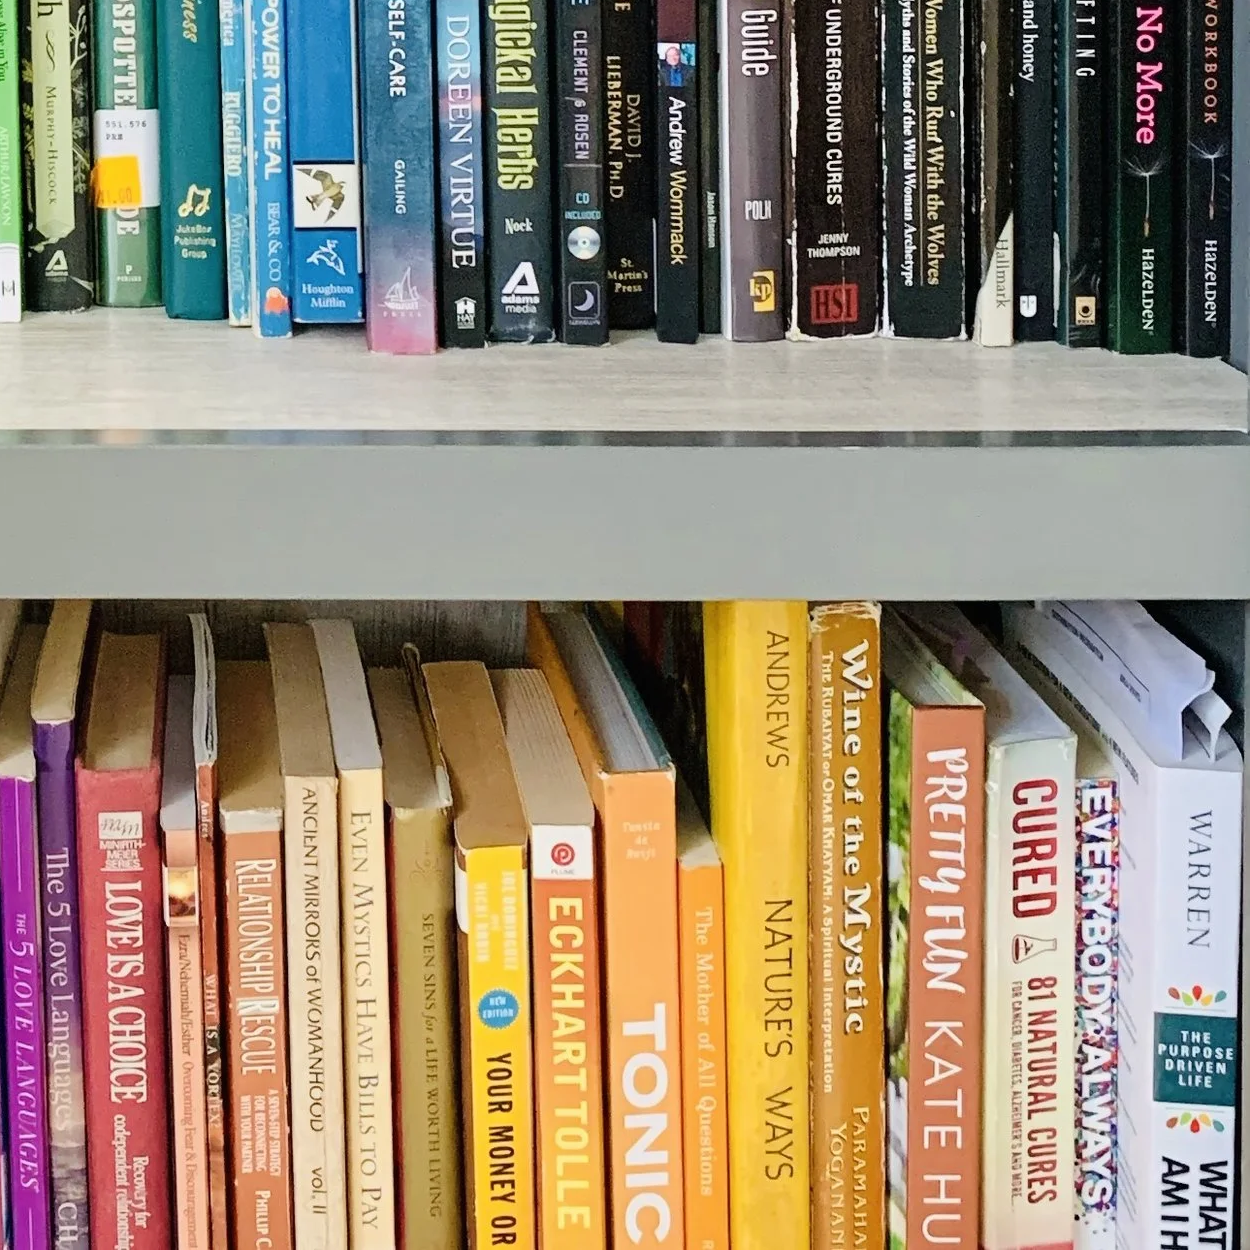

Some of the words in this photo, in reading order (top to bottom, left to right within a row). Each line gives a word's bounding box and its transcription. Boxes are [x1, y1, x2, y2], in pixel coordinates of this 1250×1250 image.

[1135, 6, 1163, 54] No
[667, 96, 688, 167] Andrew
[1135, 61, 1163, 146] More
[394, 159, 408, 216] GAILING
[490, 106, 539, 193] Herbs
[668, 170, 689, 266] Wommack
[806, 246, 861, 259] THOMPSON
[817, 232, 849, 245] JENNY
[765, 629, 790, 769] ANDREWS
[1011, 778, 1059, 919] CURED
[1186, 809, 1213, 949] WARREN
[104, 879, 143, 949] LOVE
[105, 951, 145, 978] IS
[106, 980, 145, 1004] A
[548, 896, 588, 1093] ECKHART
[763, 899, 794, 1059] NATURE'S
[1026, 975, 1058, 1001] 81
[106, 1005, 148, 1104] CHOICE
[1026, 1009, 1058, 1121] NATURAL
[1157, 1043, 1234, 1061] PURPOSE
[1164, 1058, 1227, 1075] DRIVEN
[1180, 1030, 1212, 1046] THE
[923, 1020, 964, 1150] KATE
[1177, 1074, 1213, 1089] LIFE
[621, 1002, 672, 1245] TONIC
[764, 1085, 794, 1181] WAYS
[554, 1100, 591, 1231] TOLLE
[1026, 1126, 1058, 1205] CURES
